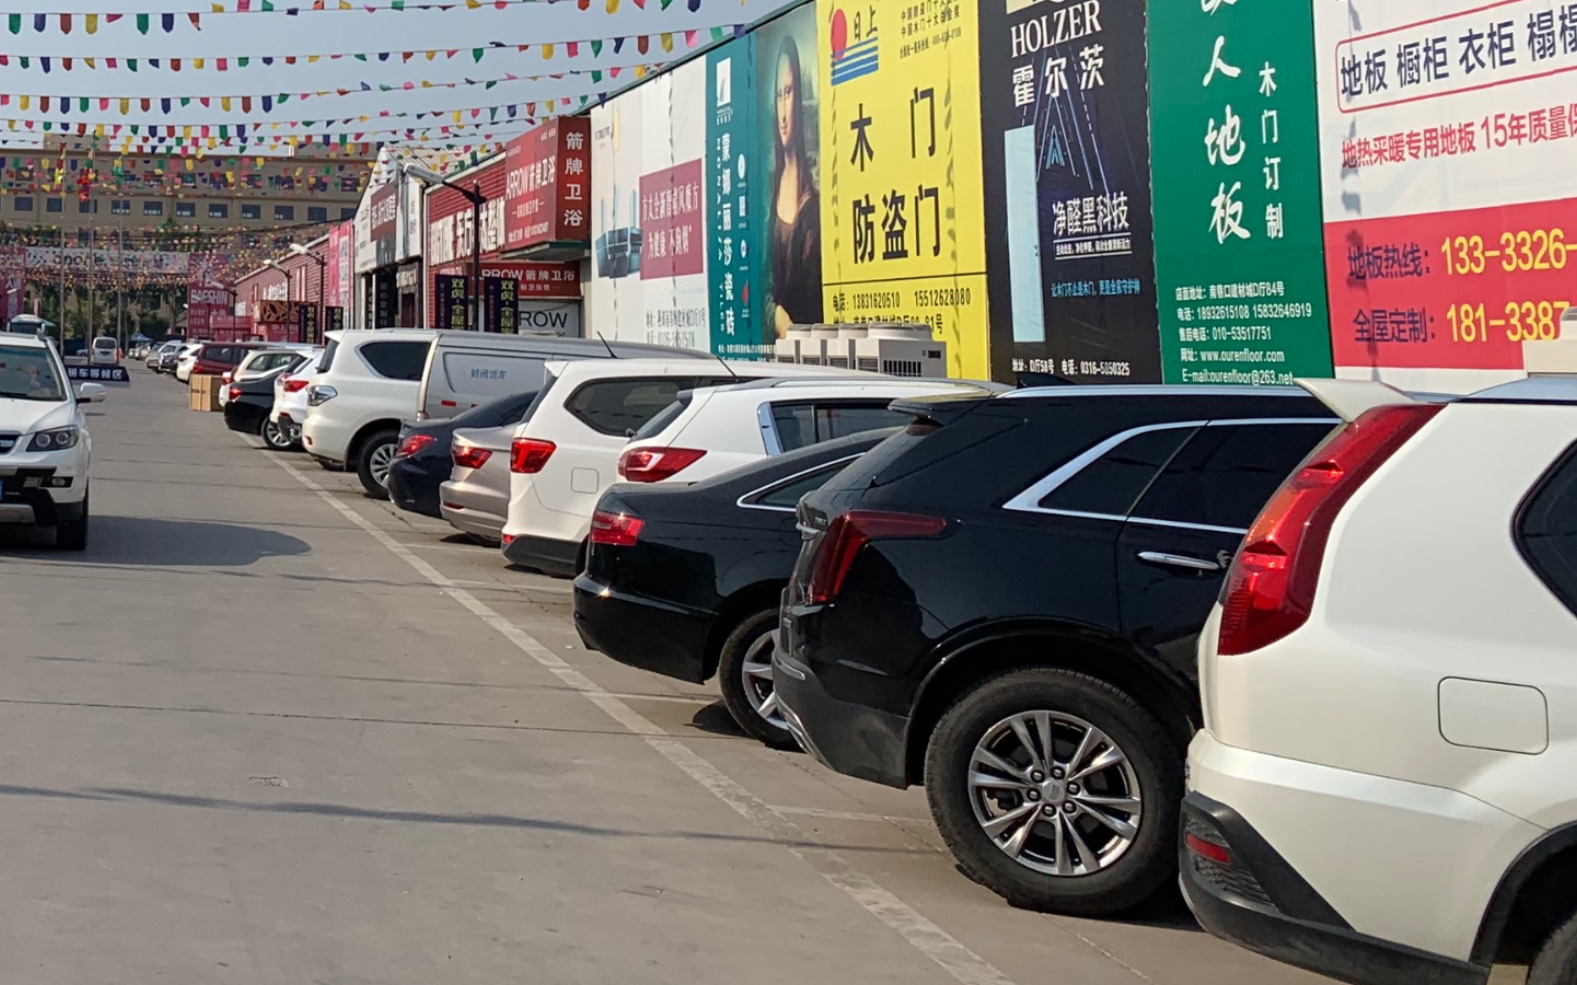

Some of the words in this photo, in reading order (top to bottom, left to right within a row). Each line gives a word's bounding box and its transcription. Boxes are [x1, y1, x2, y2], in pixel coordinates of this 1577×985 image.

[1010, 0, 1102, 59] HOLZER
[1340, 49, 1388, 97] 地板
[1396, 36, 1450, 89] 橱柜
[1459, 20, 1517, 75] 衣柜
[1012, 44, 1105, 108] 霍尔茨
[850, 87, 937, 172] 木门
[1258, 61, 1284, 240] 木门订制
[1341, 121, 1477, 170] 地热采暖专用地板
[564, 131, 585, 227] 箭牌卫浴
[852, 184, 941, 265] 防盗门
[1052, 191, 1130, 237] 净醛黑科技
[525, 269, 576, 281] 箭牌卫浴
[1252, 302, 1312, 319] 15832646919
[1200, 348, 1285, 364] www.ourenfloor.com
